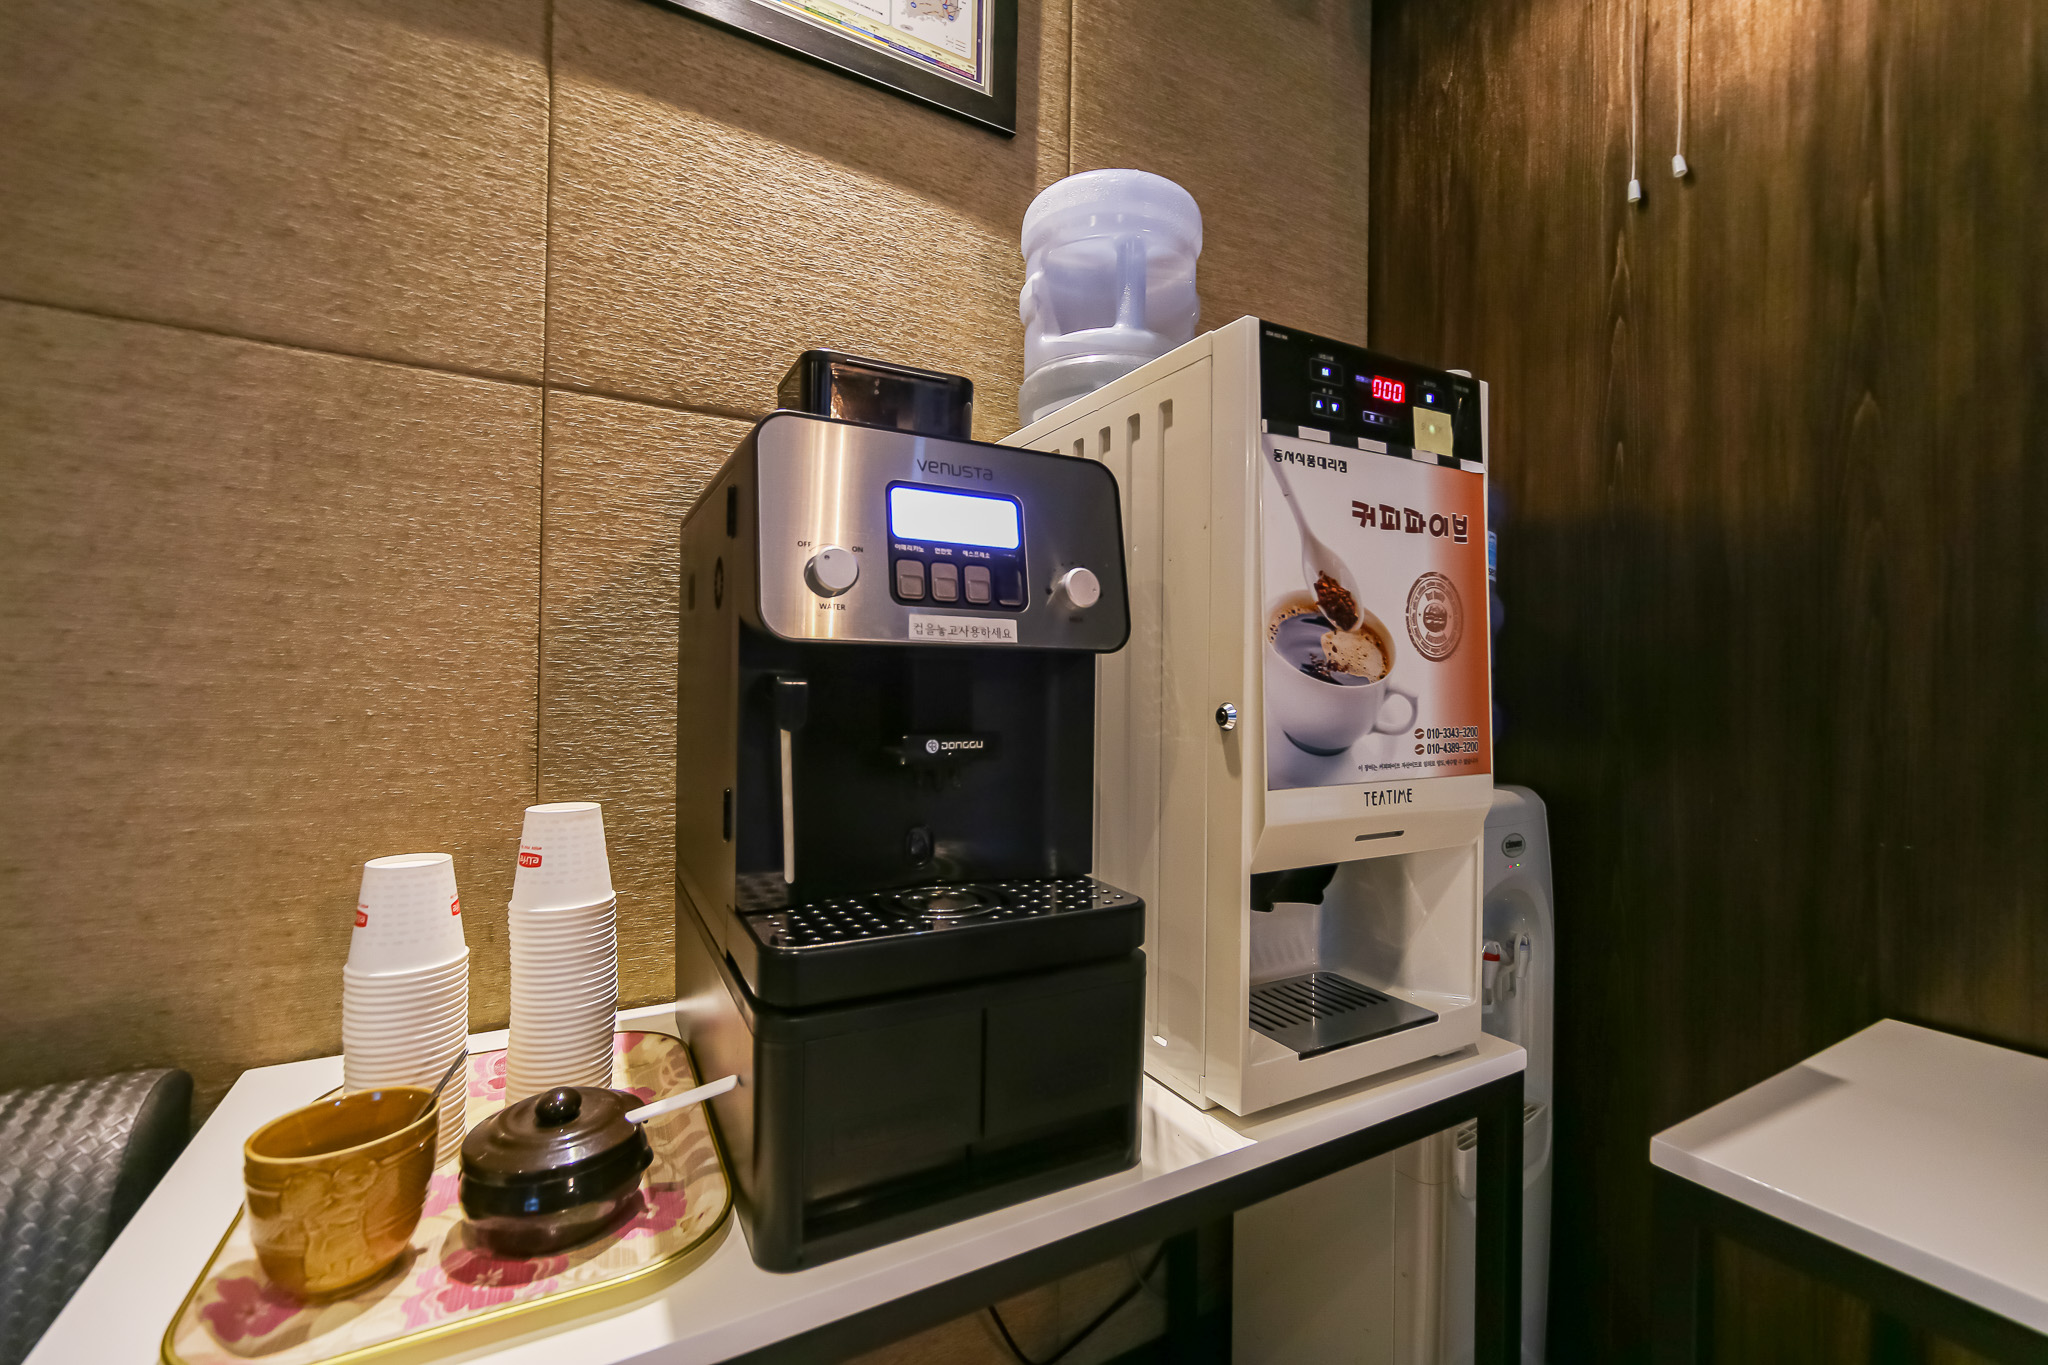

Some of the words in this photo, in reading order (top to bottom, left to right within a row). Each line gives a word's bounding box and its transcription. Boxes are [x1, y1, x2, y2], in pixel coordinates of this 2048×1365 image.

[1373, 378, 1403, 403] 000
[1351, 500, 1469, 545] 커피파이브
[797, 540, 812, 548] OFF
[819, 603, 846, 611] WATER
[1426, 726, 1479, 740] 010-3343-3200
[941, 740, 984, 750] DONGGU
[1426, 741, 1479, 755] 010-4389-3200
[1363, 788, 1413, 807] TEATIME
